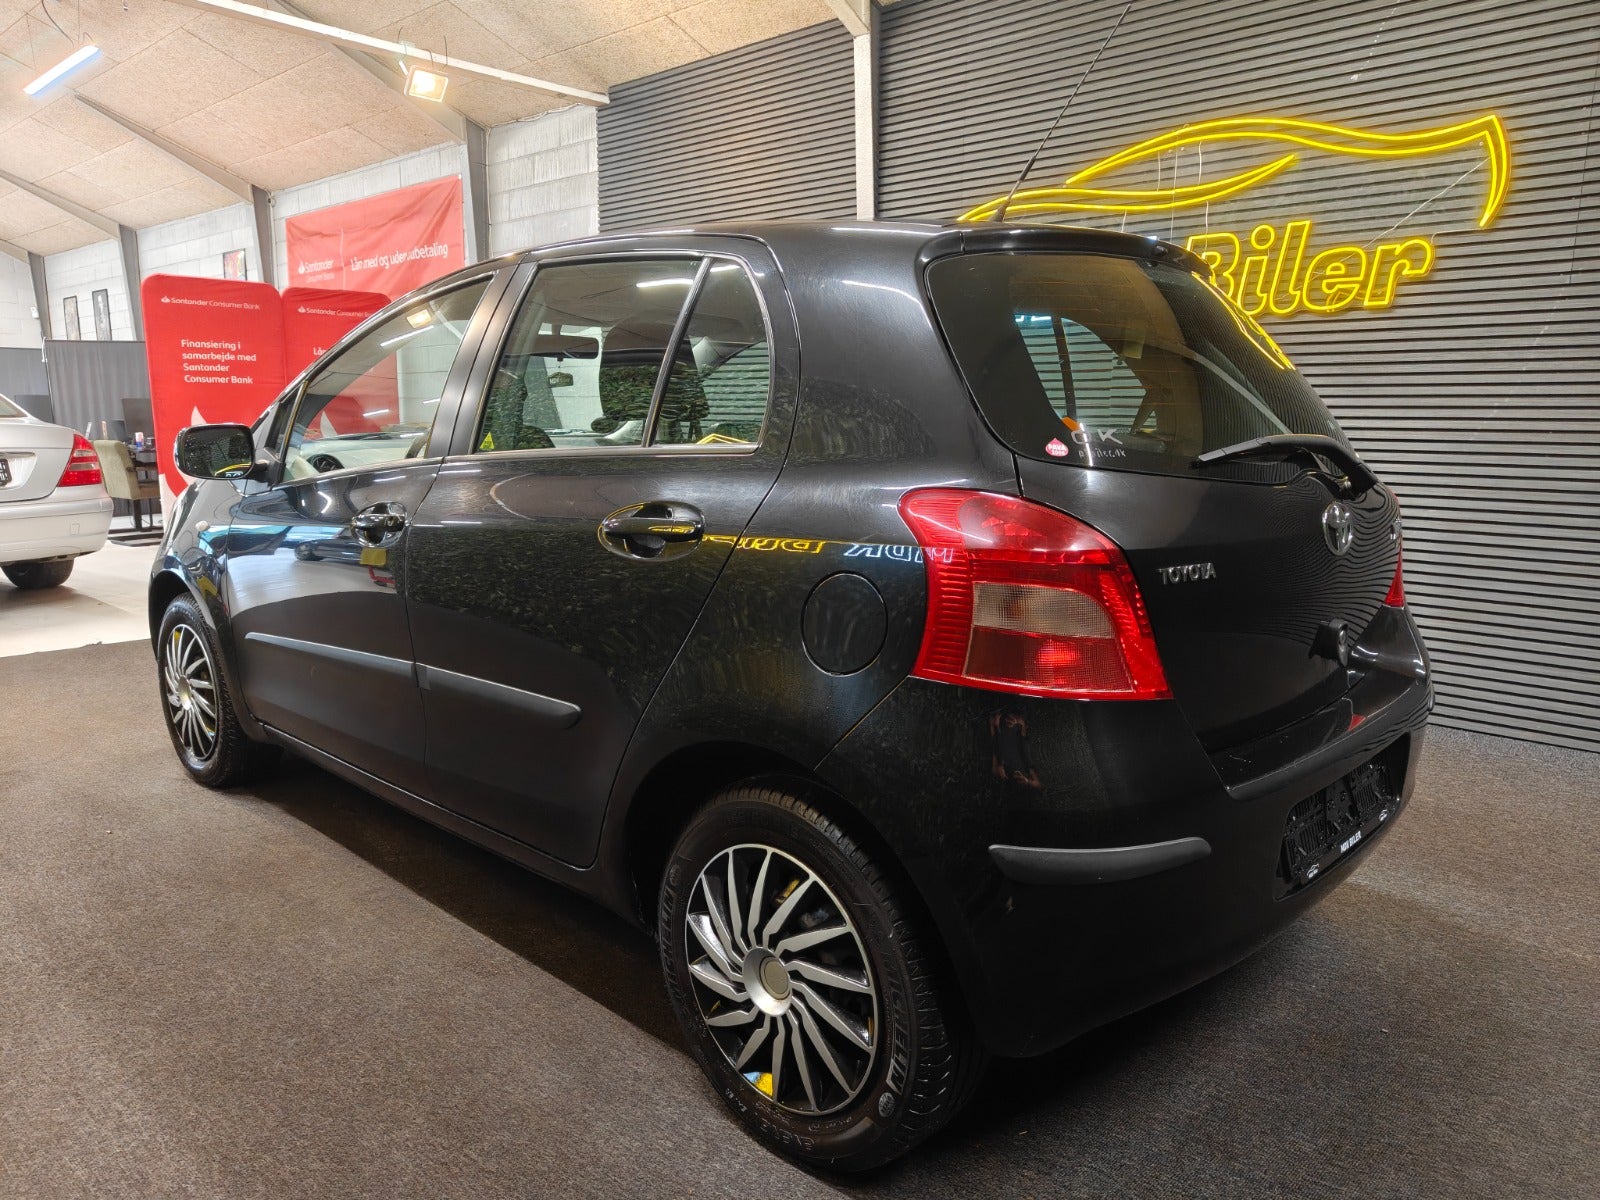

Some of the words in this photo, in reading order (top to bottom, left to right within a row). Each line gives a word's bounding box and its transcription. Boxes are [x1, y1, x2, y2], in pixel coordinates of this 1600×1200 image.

[305, 260, 334, 273] Santander
[363, 256, 378, 269] med
[379, 255, 390, 269] og
[1186, 219, 1434, 315] Biler
[171, 297, 208, 306] Santander
[209, 300, 243, 309] Consumer
[306, 307, 336, 316] Santander
[181, 339, 236, 351] Finansiering
[182, 352, 235, 362] samarbejde
[237, 353, 257, 361] med
[183, 363, 230, 372] Santander
[184, 374, 230, 383] Consumer
[231, 375, 253, 384] Bank
[1157, 562, 1217, 585] TOYOTA
